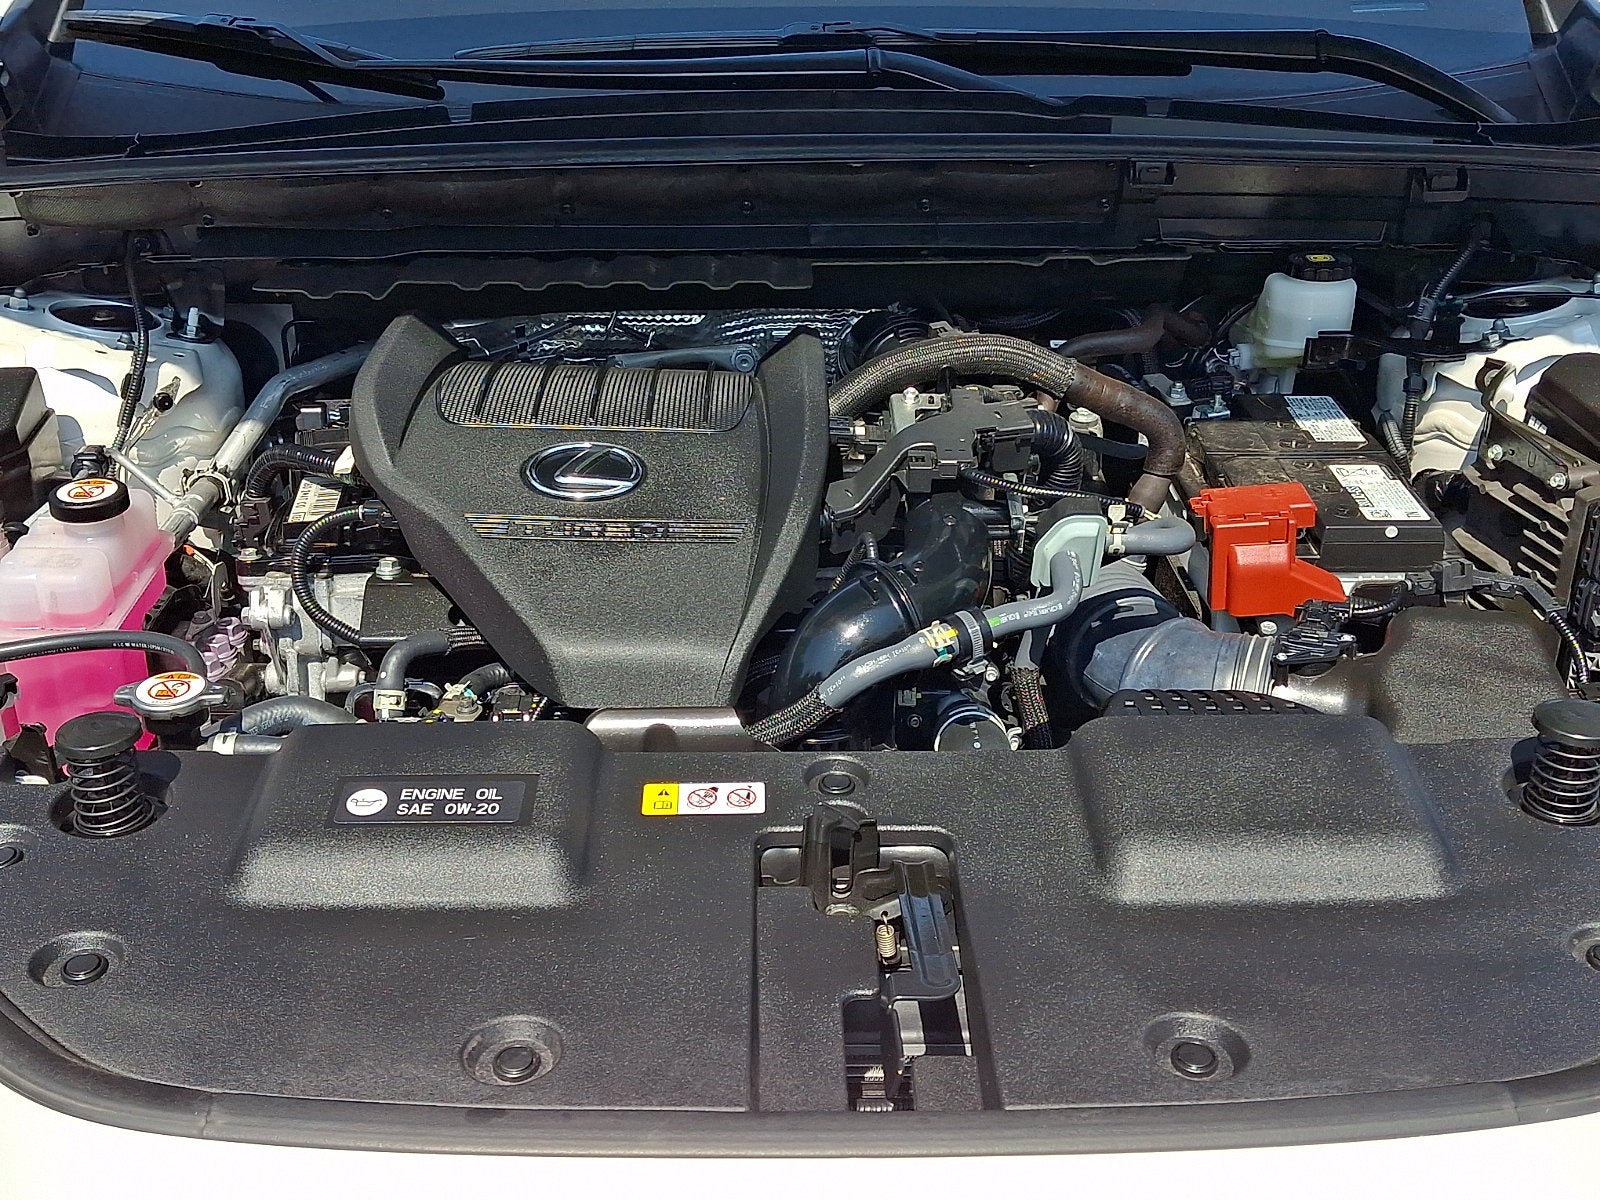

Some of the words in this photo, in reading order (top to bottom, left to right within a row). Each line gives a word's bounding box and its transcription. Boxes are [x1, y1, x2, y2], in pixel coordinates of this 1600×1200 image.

[400, 788, 466, 800] ENGINE
[475, 788, 503, 800] OIL
[396, 803, 435, 815] SAE
[444, 803, 501, 815] 0W-20
